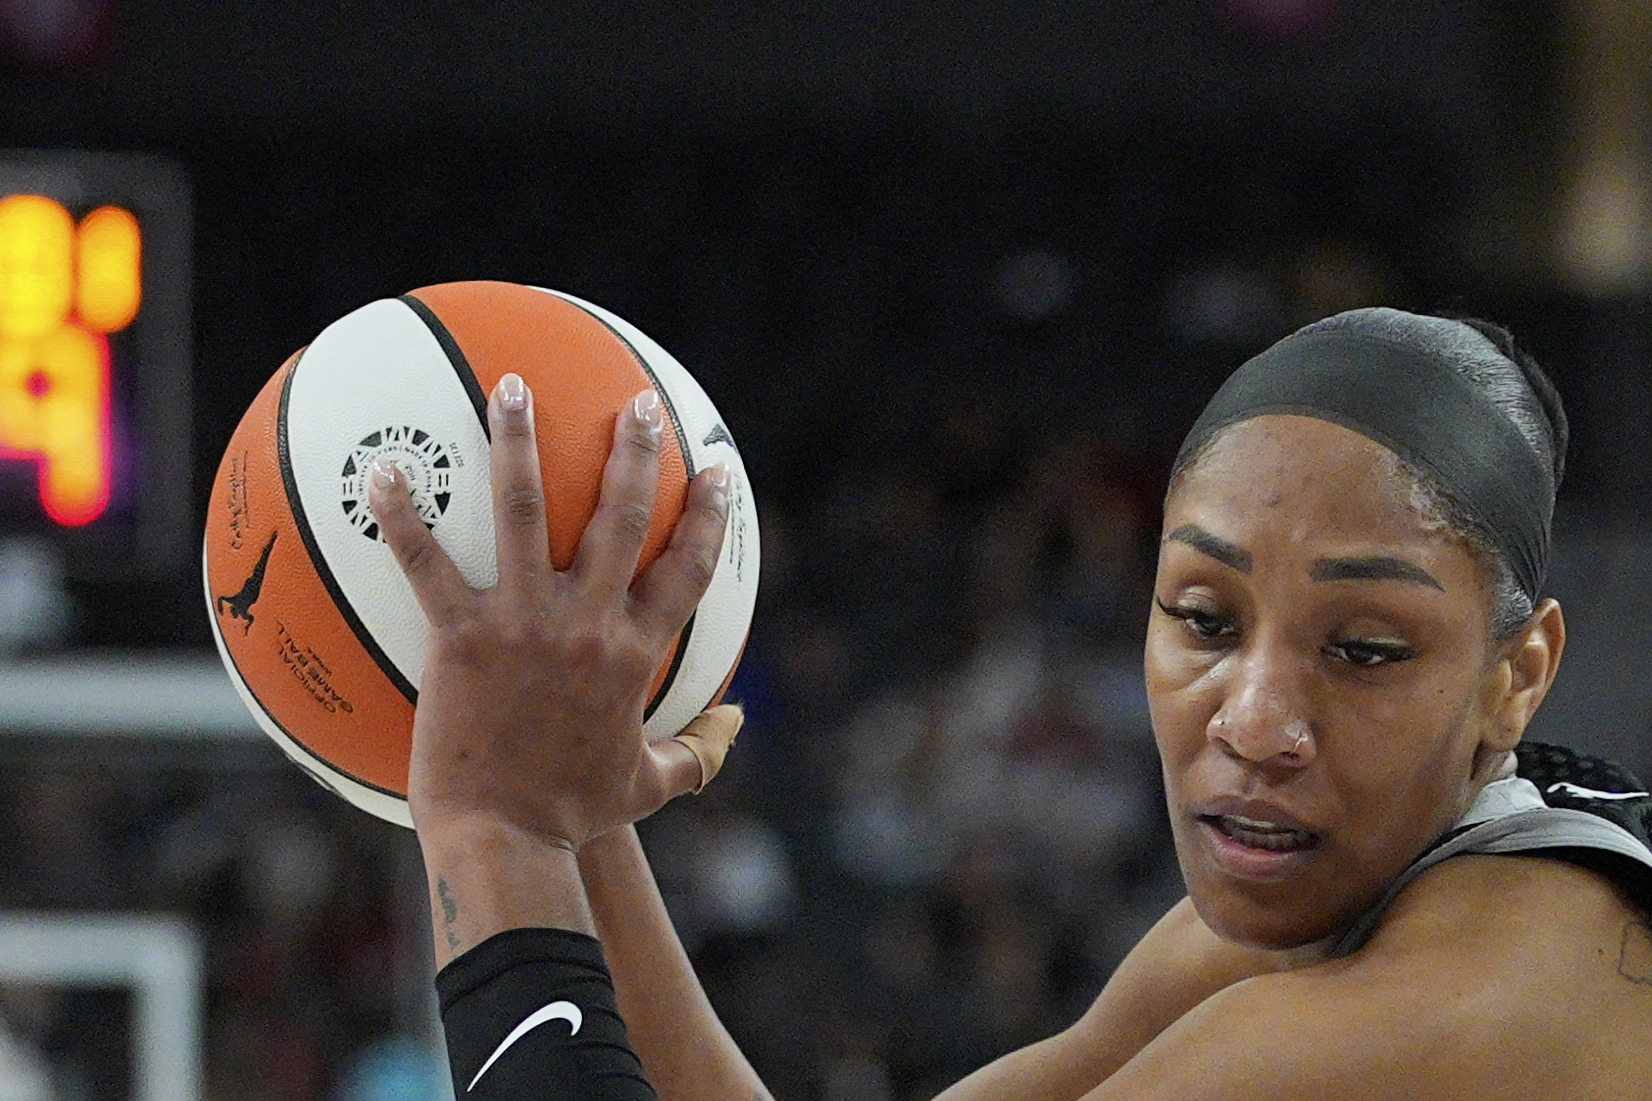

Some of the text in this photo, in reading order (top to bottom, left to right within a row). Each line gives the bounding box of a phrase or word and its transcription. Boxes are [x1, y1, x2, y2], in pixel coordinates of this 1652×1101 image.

[273, 617, 354, 713] GAME BALL
[277, 640, 336, 713] OFFICIAL
